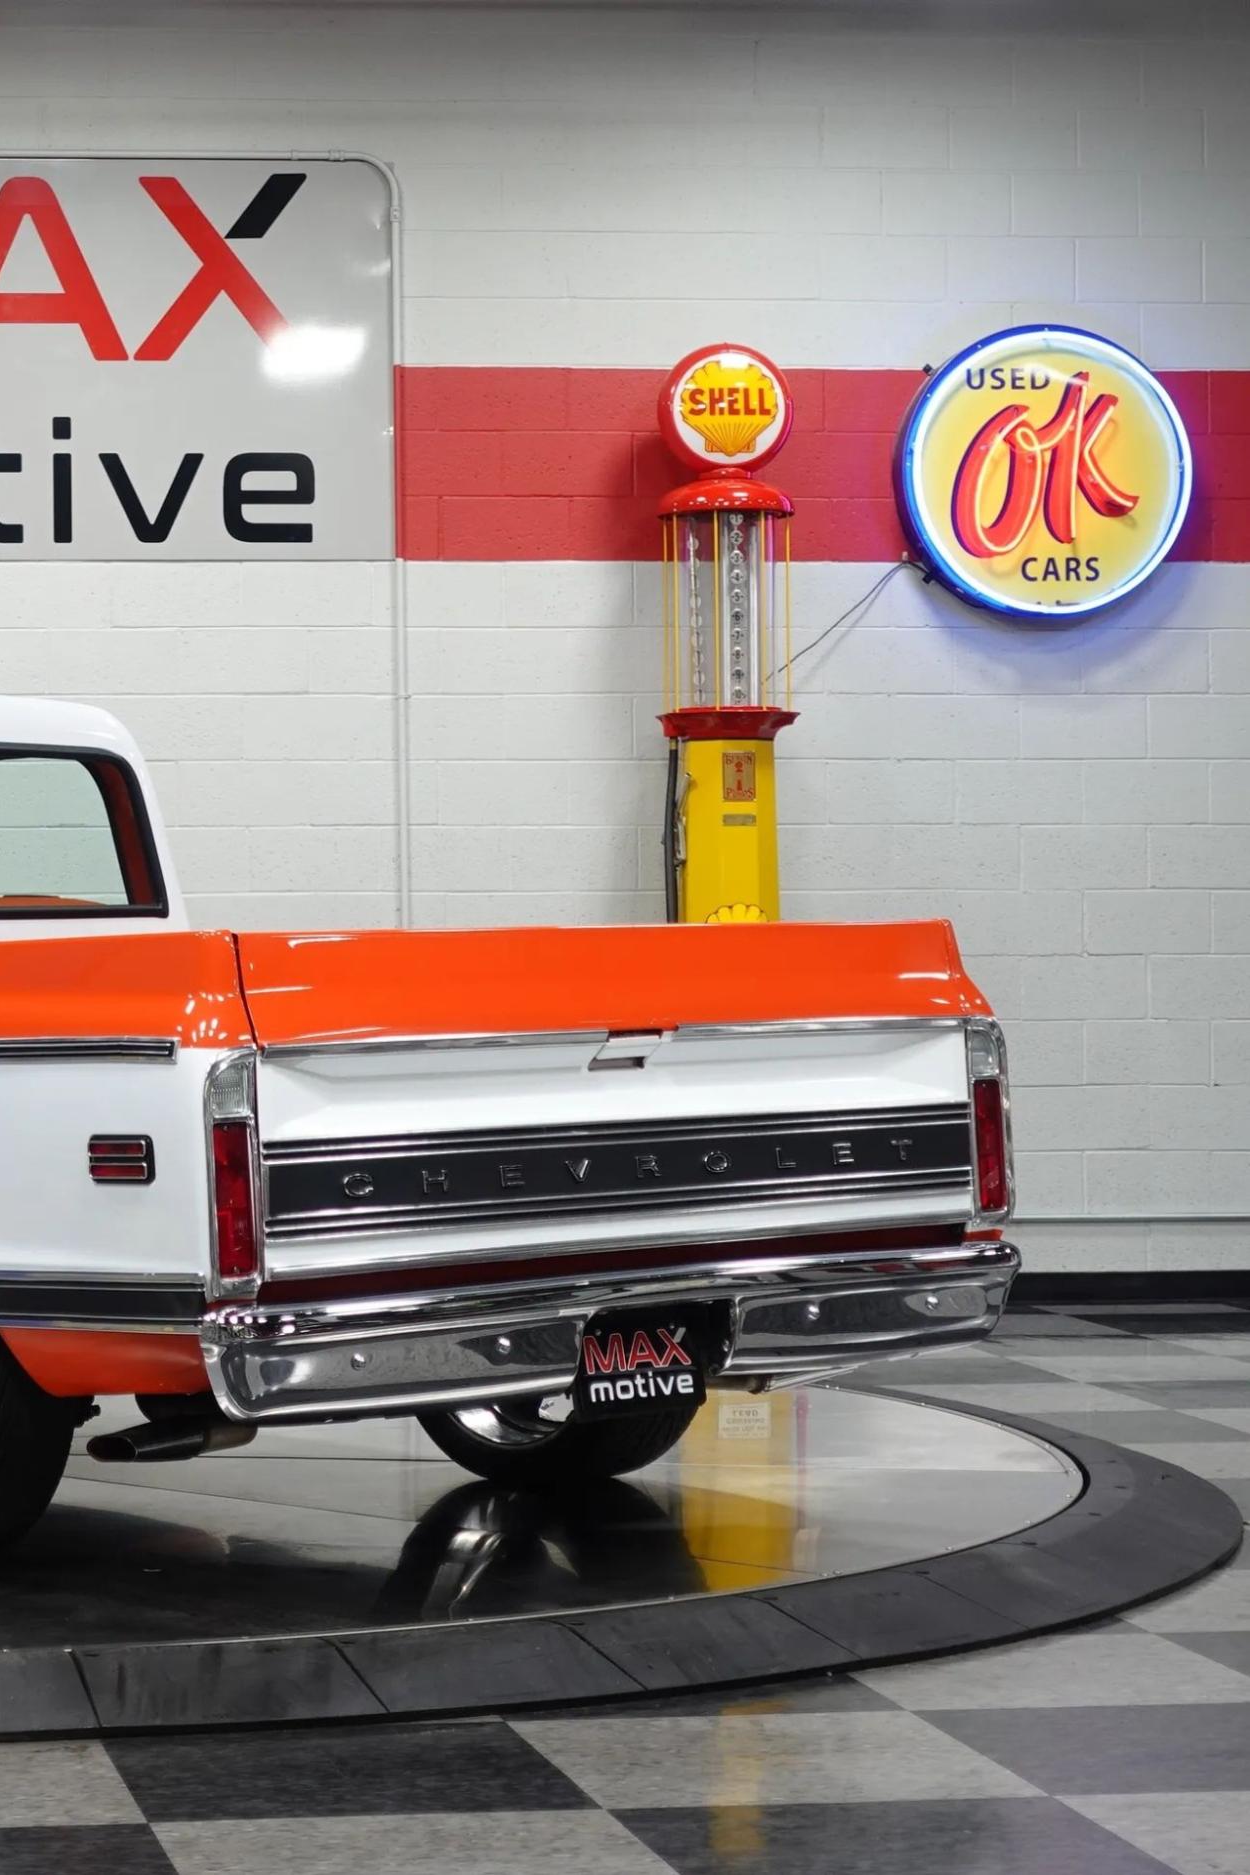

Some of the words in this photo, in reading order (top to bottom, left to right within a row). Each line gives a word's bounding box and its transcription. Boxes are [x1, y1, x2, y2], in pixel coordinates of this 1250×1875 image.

[965, 368, 1050, 391] USED
[688, 388, 772, 416] SHELL
[950, 371, 1140, 559] OK
[1021, 557, 1100, 582] CARS
[343, 1138, 913, 1198] CHEVROLET
[582, 1327, 692, 1375] MAX
[590, 1371, 694, 1403] motive
